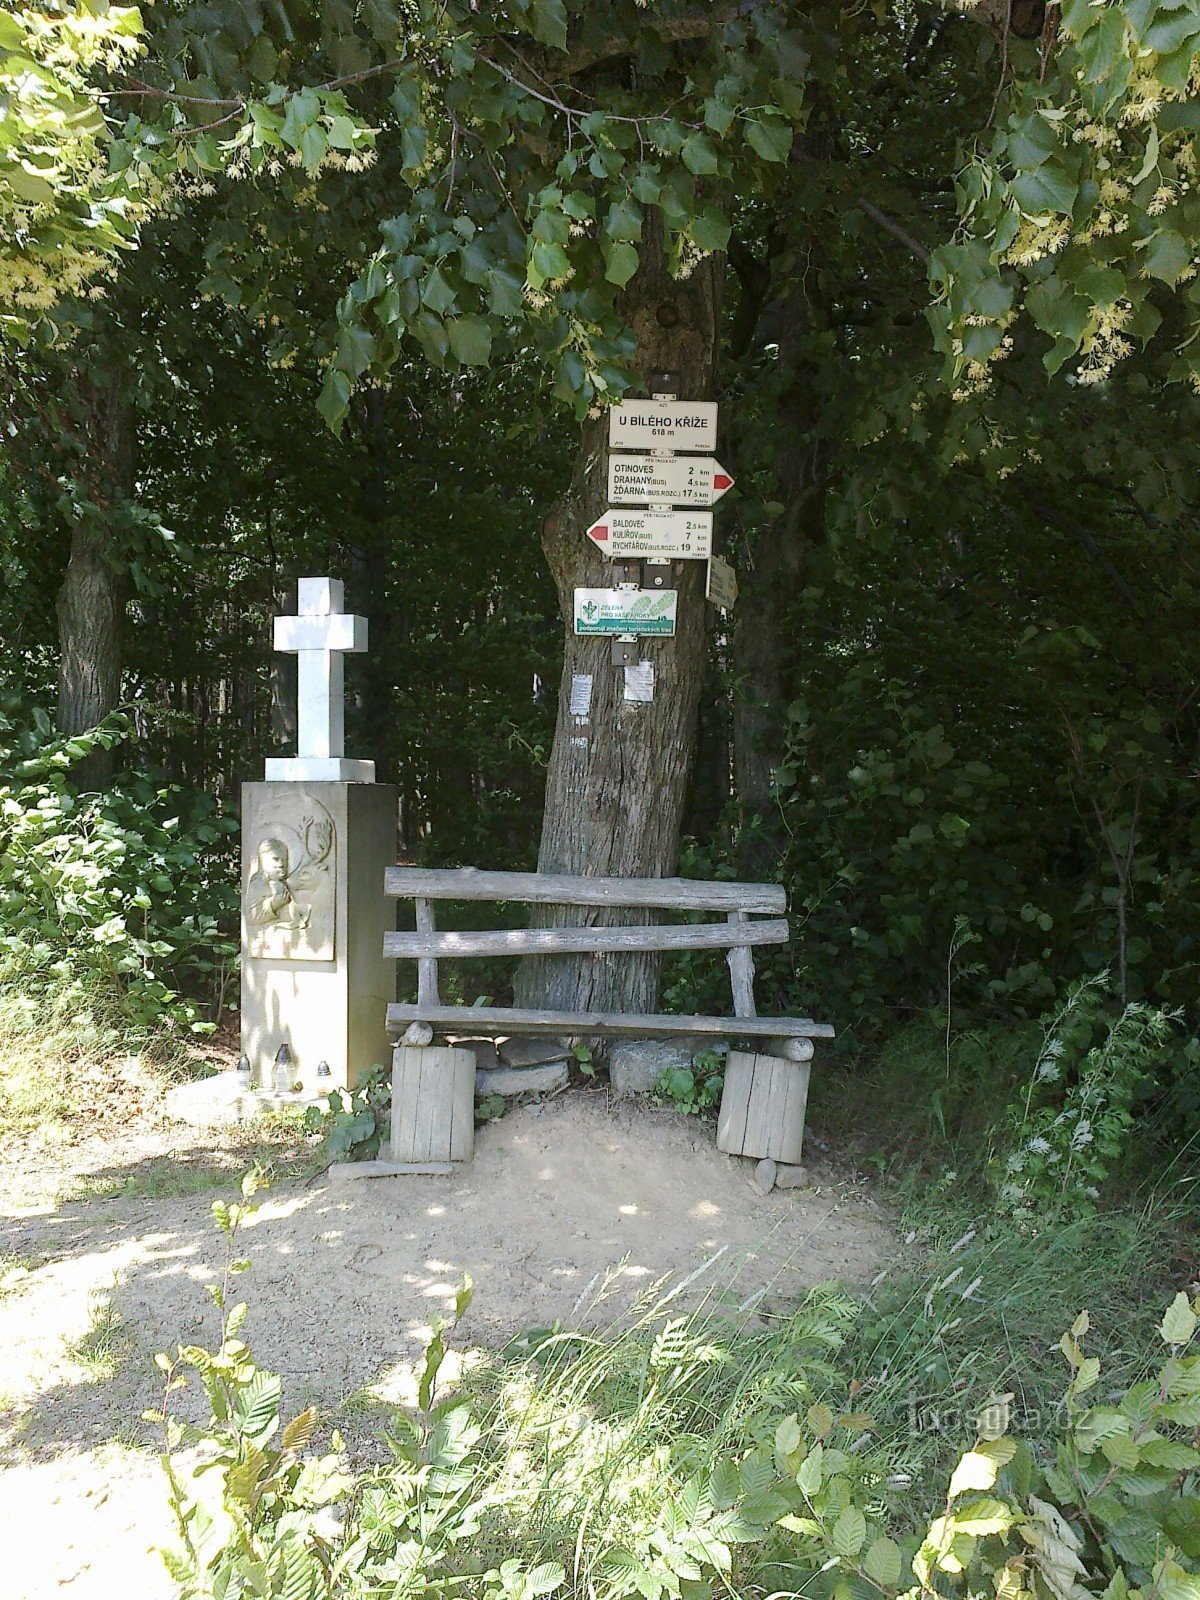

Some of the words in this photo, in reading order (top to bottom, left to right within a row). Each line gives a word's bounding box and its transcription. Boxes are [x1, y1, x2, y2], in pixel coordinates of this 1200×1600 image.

[619, 416, 627, 426] U
[630, 415, 672, 427] BÍLÉHO
[675, 416, 708, 428] KŘÍŽE
[614, 464, 654, 474] OTINOVES
[688, 467, 694, 475] 2
[612, 519, 645, 528] BALDOVEC
[686, 532, 691, 540] 7
[681, 543, 691, 551] 19
